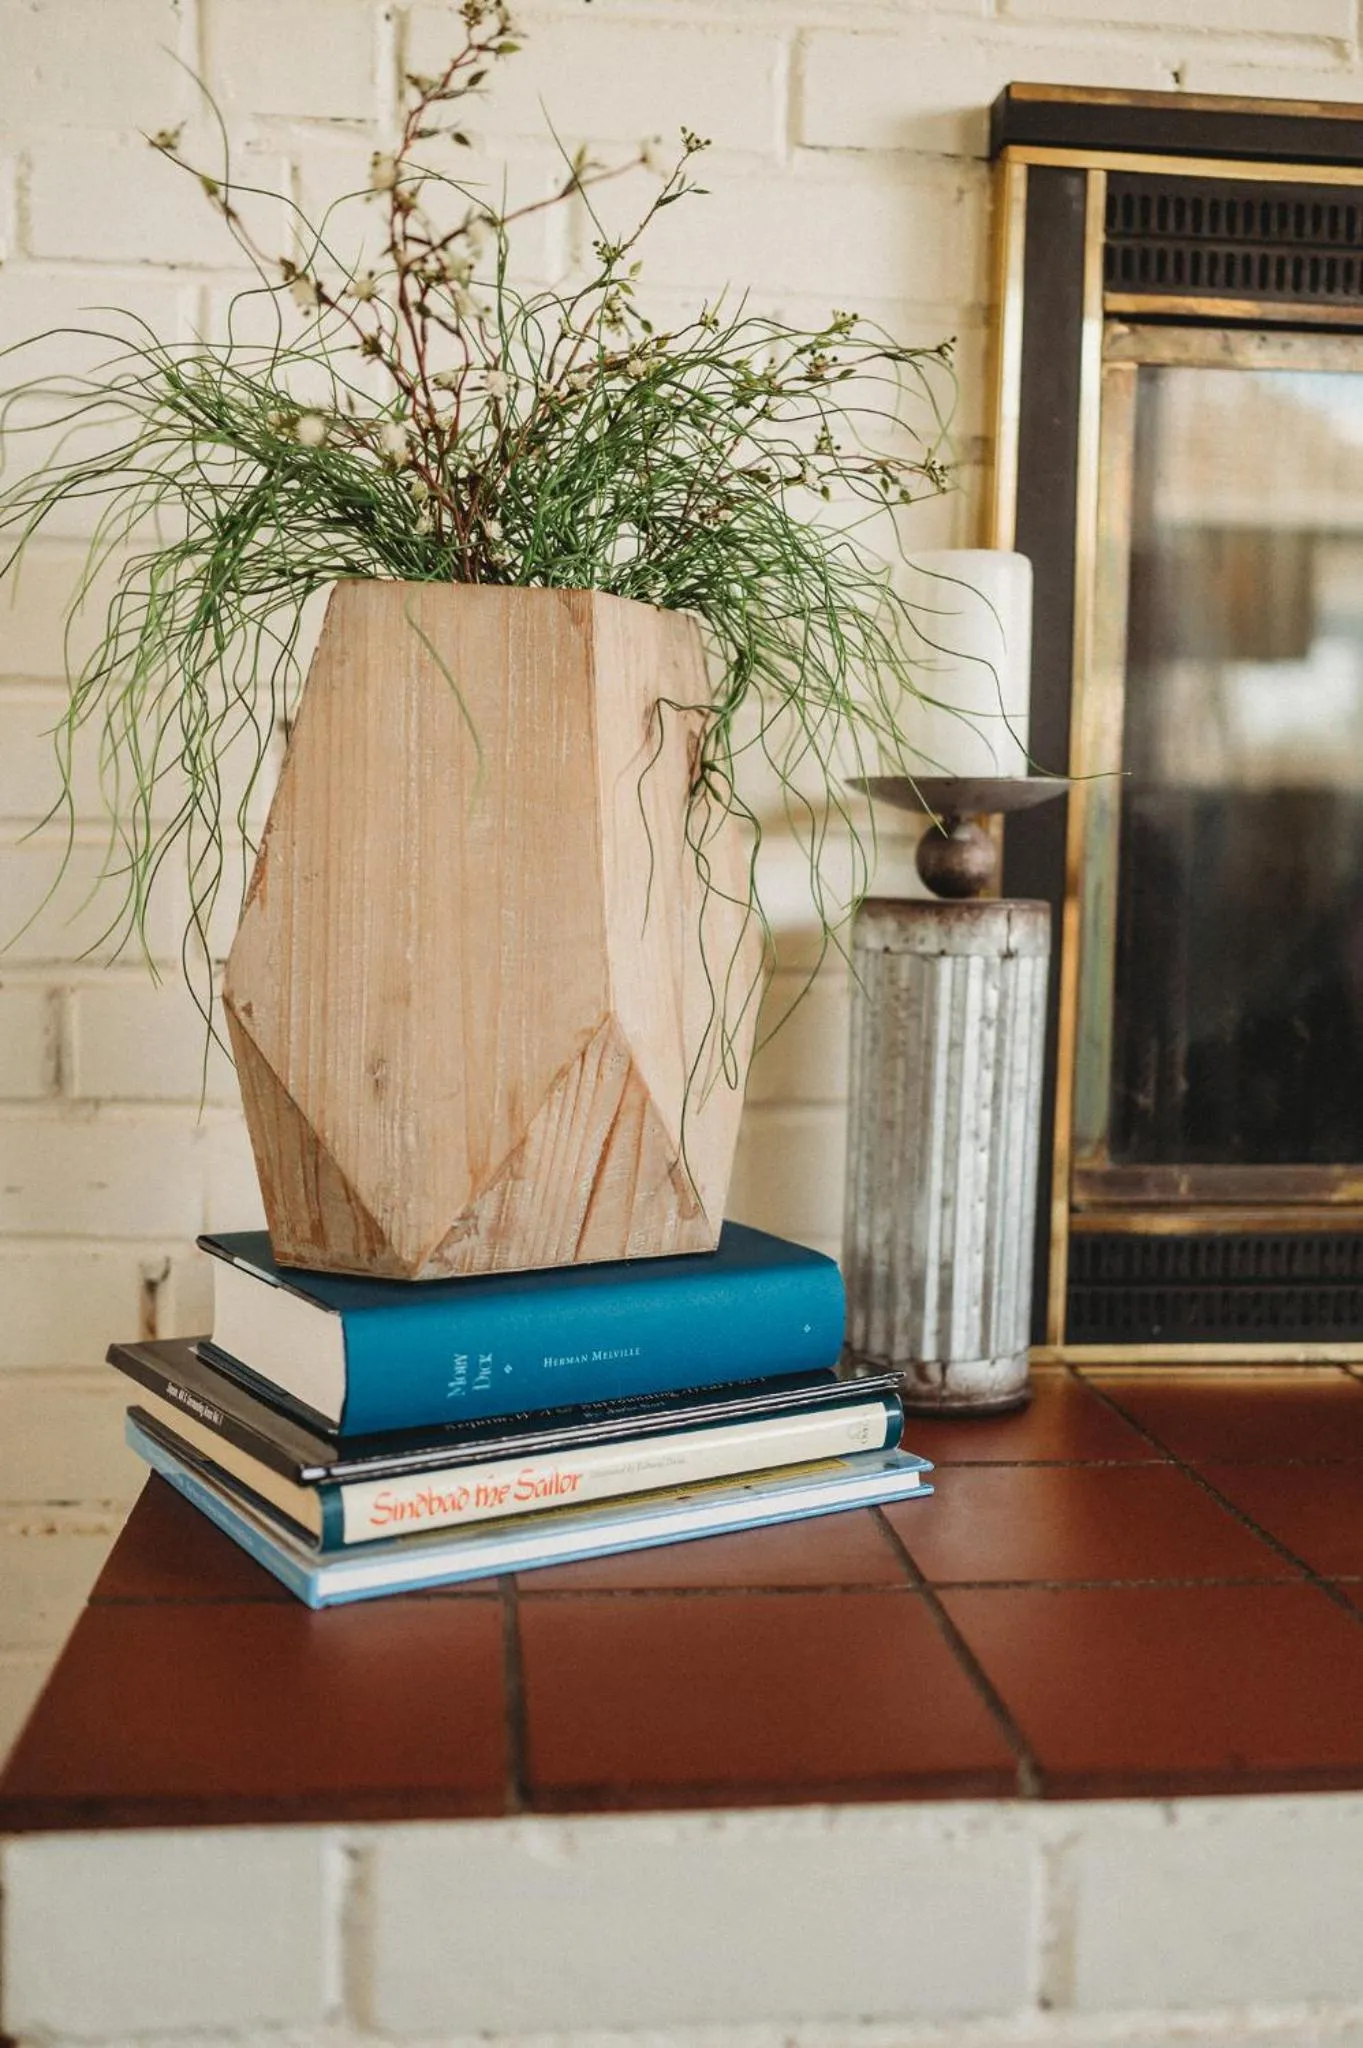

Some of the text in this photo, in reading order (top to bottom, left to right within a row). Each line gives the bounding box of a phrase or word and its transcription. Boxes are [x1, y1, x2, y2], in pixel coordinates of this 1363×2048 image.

[544, 1347, 641, 1368] HERMAN MELVILLE
[474, 1474, 511, 1508] the
[514, 1463, 583, 1501] Sailor
